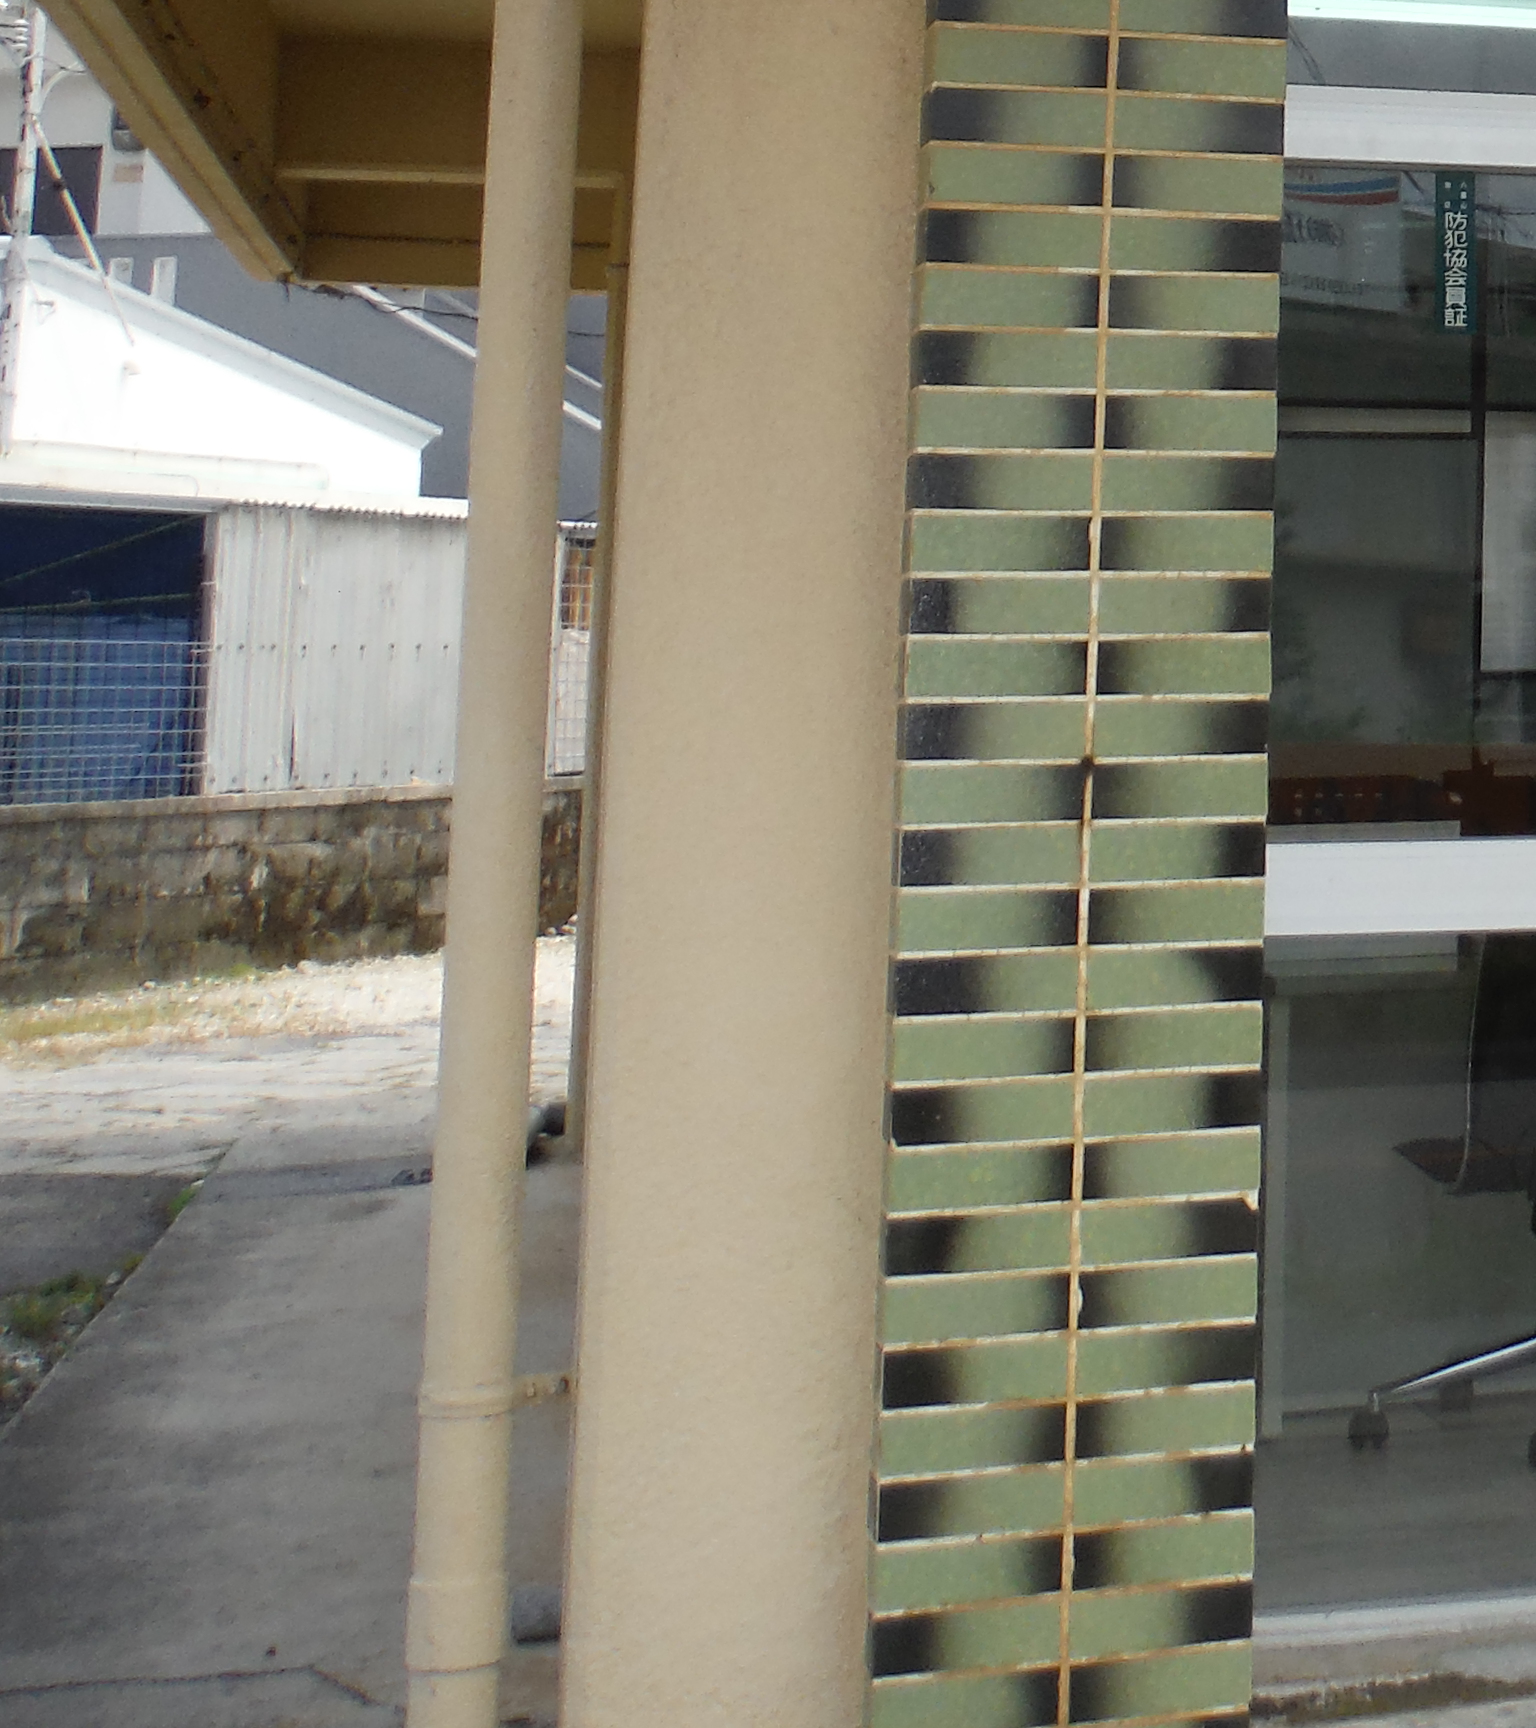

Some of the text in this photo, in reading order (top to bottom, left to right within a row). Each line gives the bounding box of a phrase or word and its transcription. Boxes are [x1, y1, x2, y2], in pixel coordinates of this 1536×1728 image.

[1443, 211, 1469, 327] 防犯協会員証
